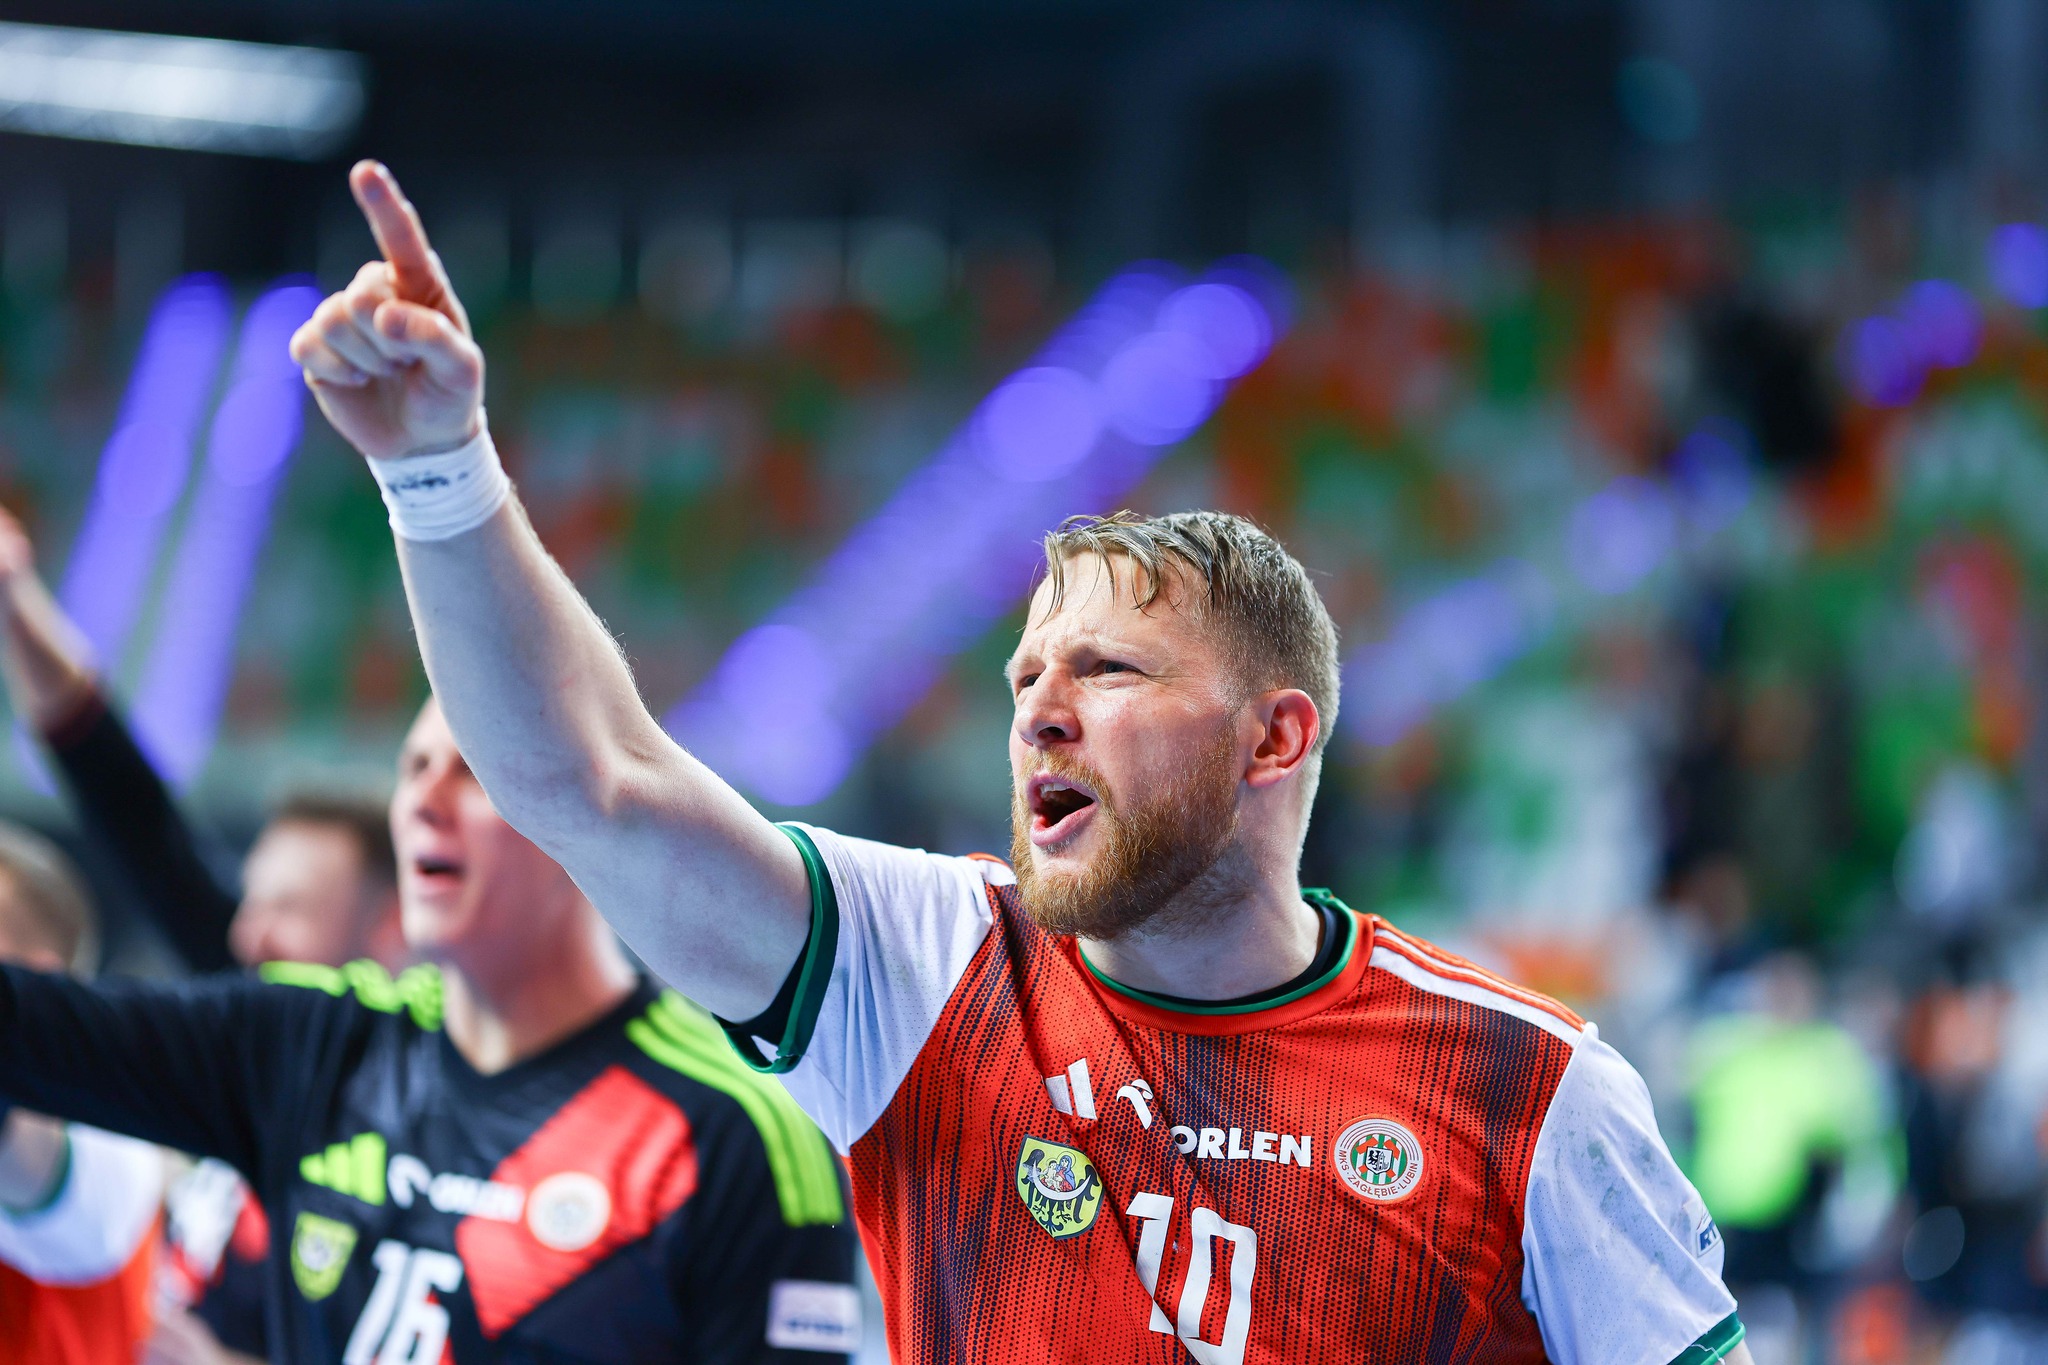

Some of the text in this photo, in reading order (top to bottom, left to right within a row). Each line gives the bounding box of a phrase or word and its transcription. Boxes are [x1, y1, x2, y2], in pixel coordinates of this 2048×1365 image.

[1170, 1125, 1312, 1168] ORLEN
[1338, 1149, 1418, 1198] MKS ZAGŁĘBIE LUBIN
[342, 1238, 464, 1365] 16
[1125, 1191, 1258, 1365] 10
